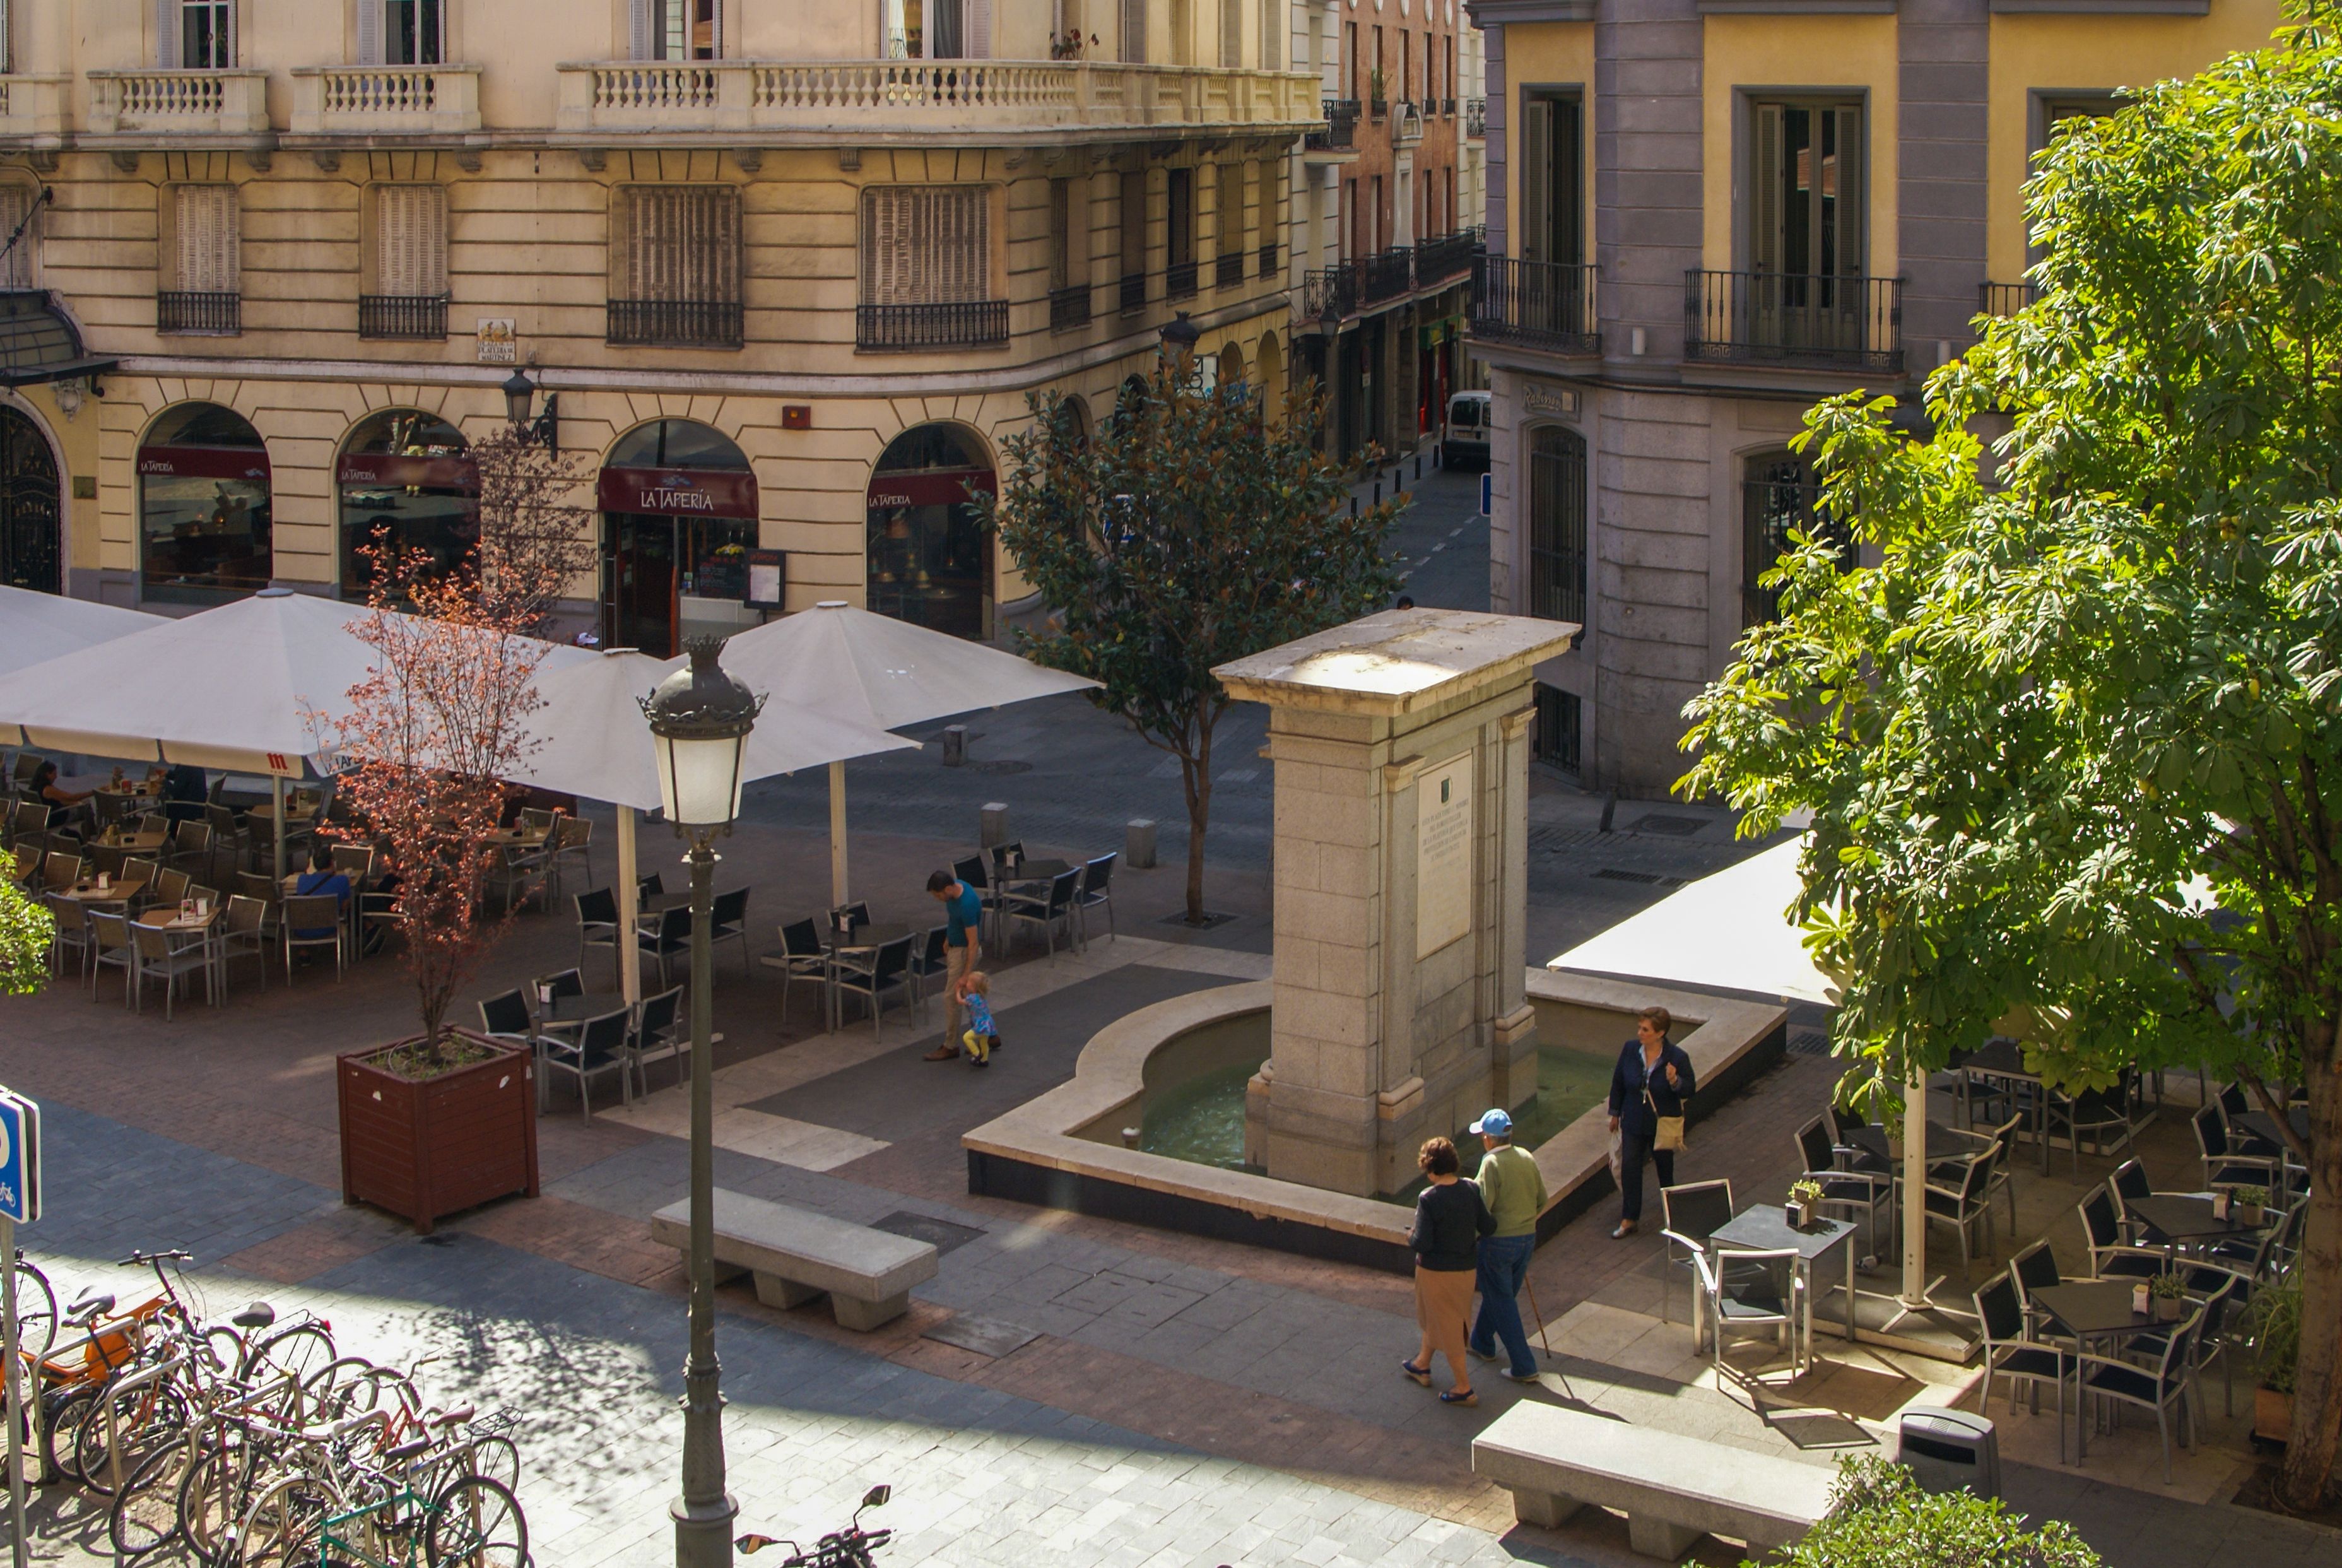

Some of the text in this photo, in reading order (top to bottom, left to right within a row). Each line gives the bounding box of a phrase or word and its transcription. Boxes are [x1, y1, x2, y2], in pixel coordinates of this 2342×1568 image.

[141, 463, 148, 471] LA
[341, 471, 350, 480] LA
[641, 487, 714, 511] LA TAPERÍA
[869, 497, 878, 507] LA
